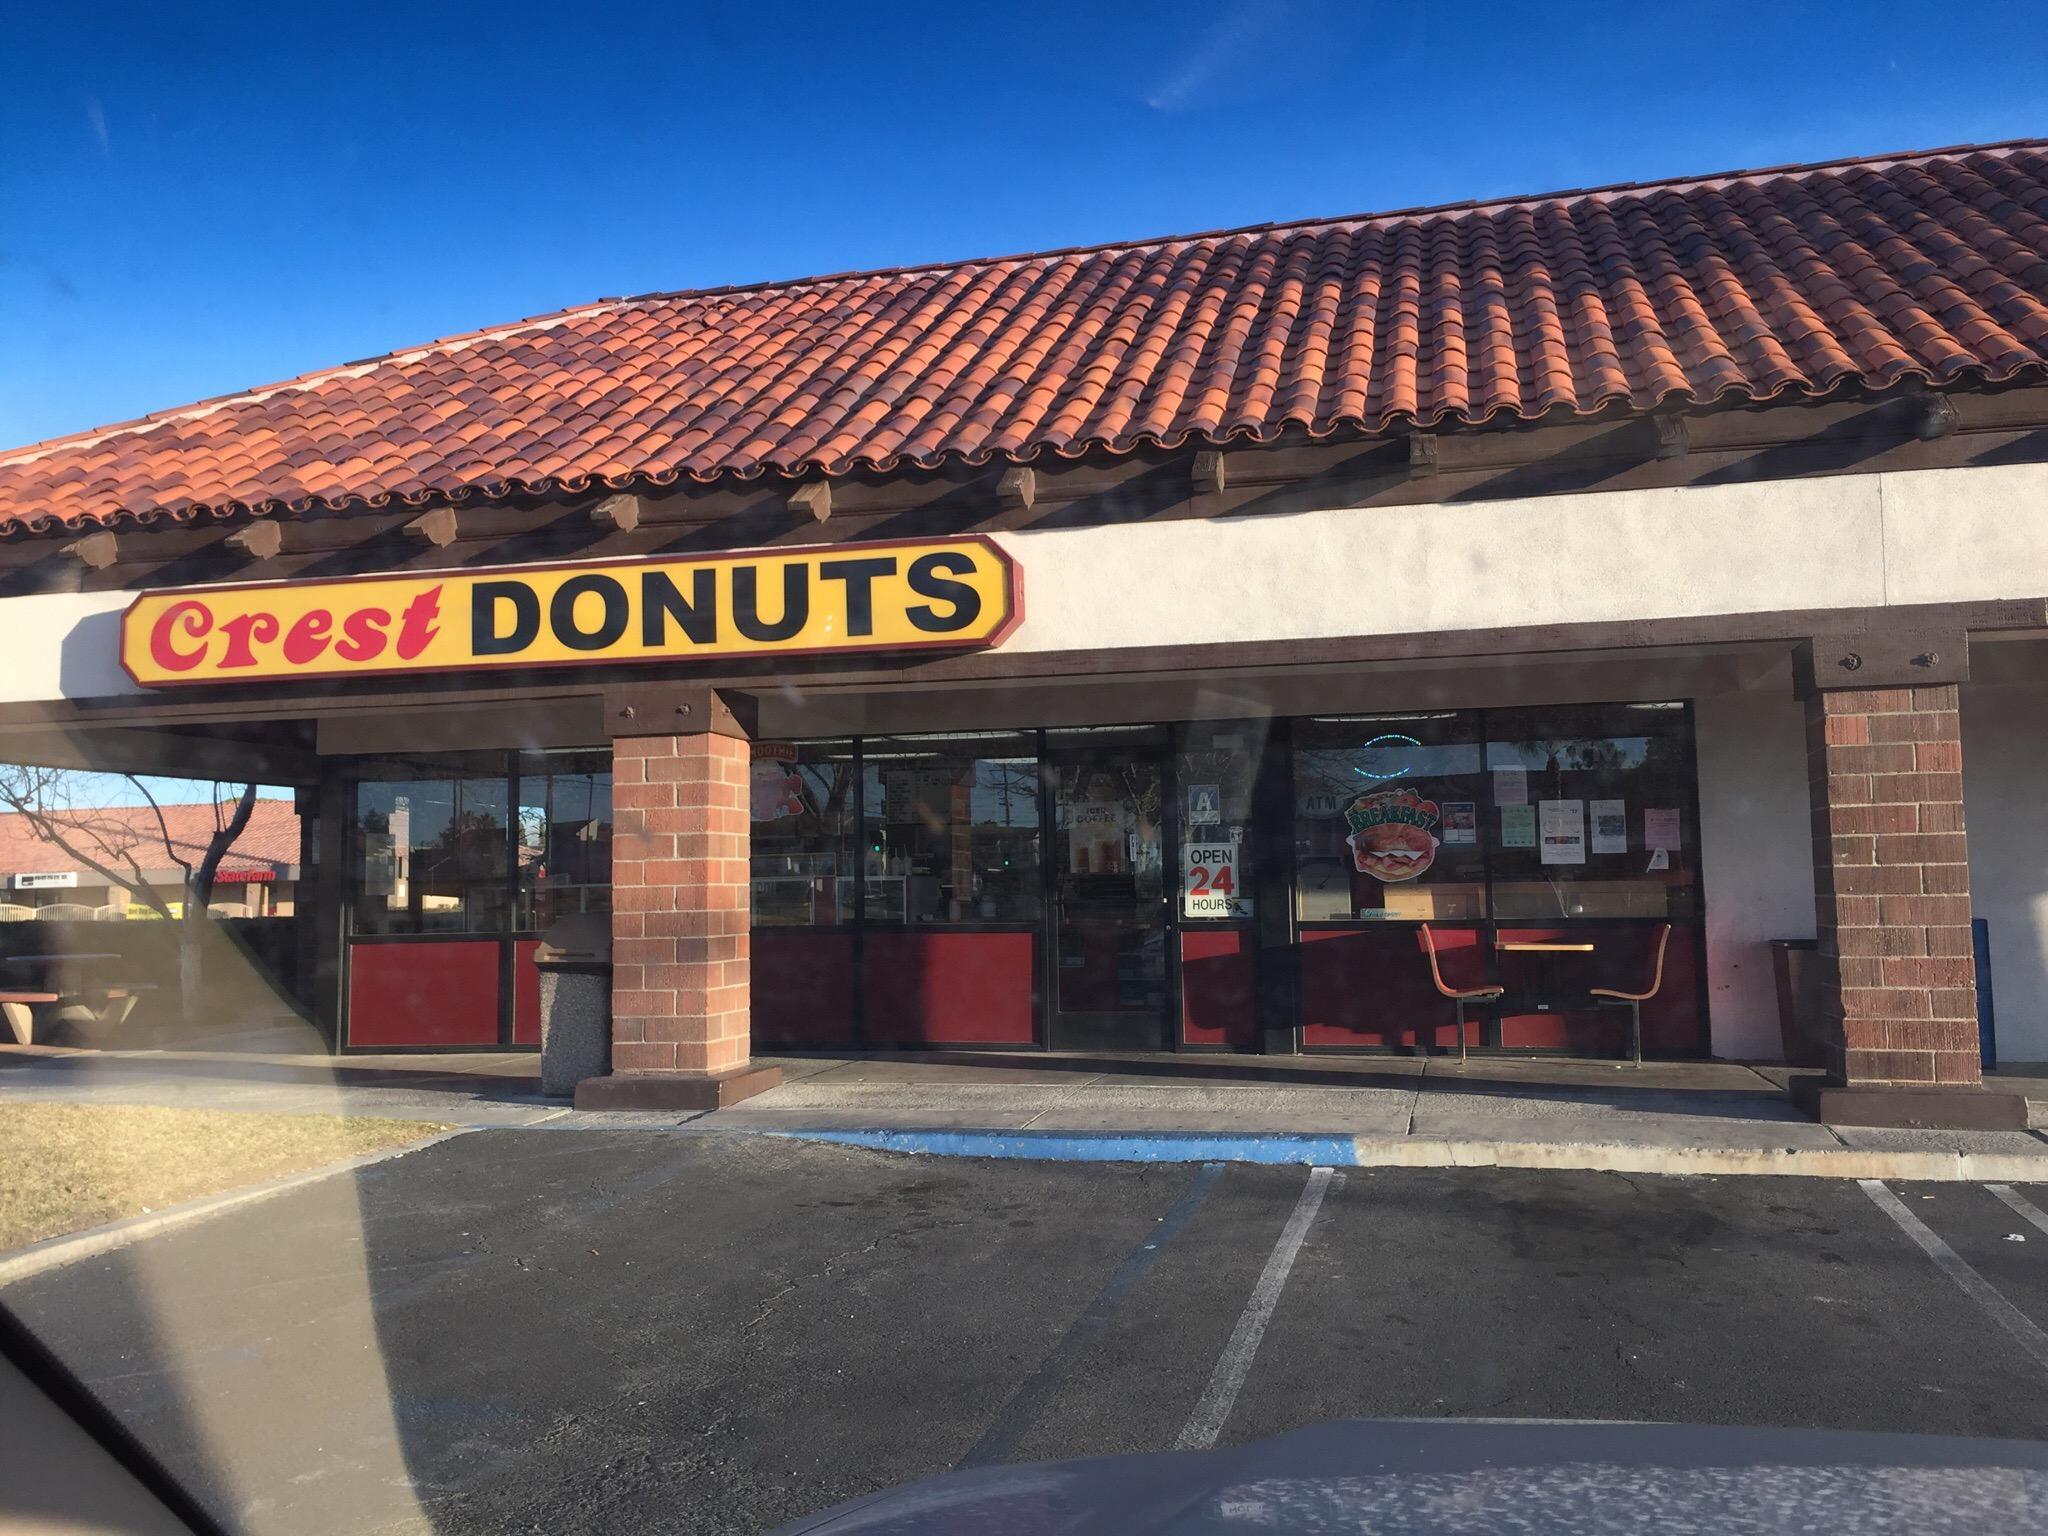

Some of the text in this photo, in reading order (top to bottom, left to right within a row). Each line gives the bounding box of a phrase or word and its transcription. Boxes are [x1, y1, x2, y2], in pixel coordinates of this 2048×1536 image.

[149, 551, 982, 671] Crest DONUTS
[1196, 791, 1213, 811] A
[1306, 796, 1337, 810] ATM
[1348, 805, 1437, 834] BREAKFAST
[1190, 849, 1233, 864] OPEN
[1188, 865, 1235, 895] 24
[1192, 898, 1233, 911] HOURS
